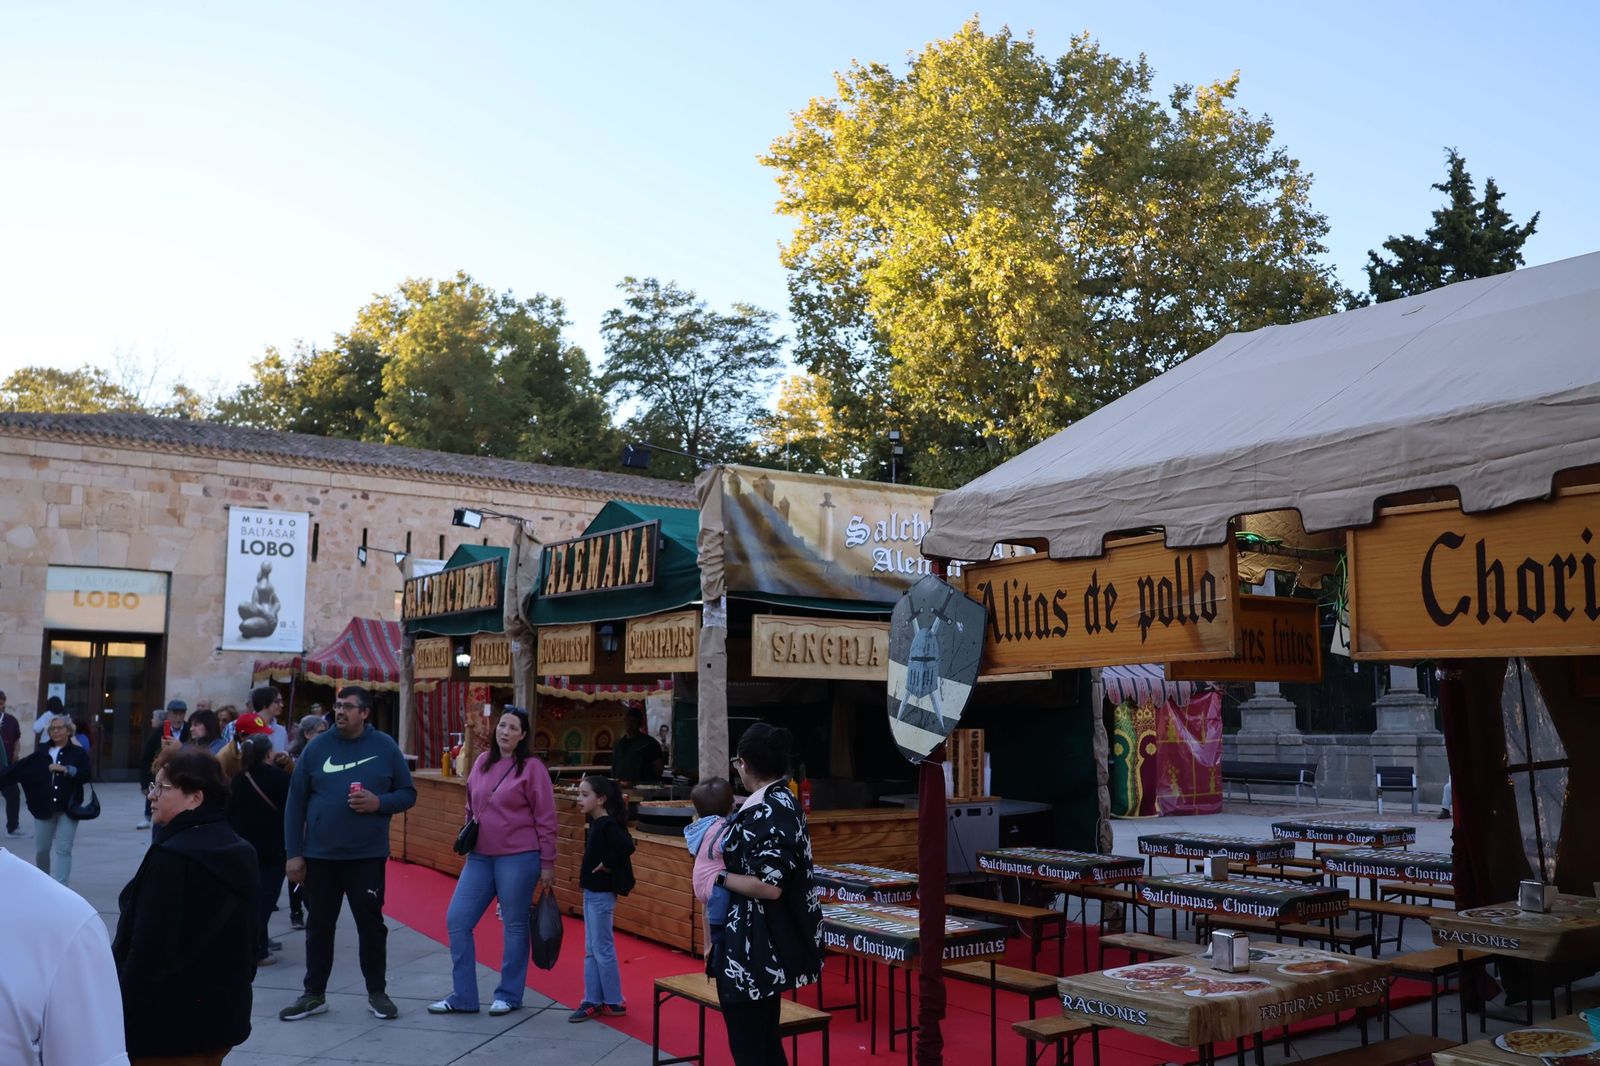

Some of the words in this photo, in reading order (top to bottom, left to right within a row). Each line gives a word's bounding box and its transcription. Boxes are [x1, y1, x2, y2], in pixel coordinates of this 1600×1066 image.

[242, 515, 297, 527] MUSEO
[240, 526, 296, 541] BALTASAR
[240, 540, 295, 558] LOBO
[545, 526, 650, 595] ALEMANA
[1421, 528, 1600, 627] Chori
[73, 589, 141, 610] LOBO
[977, 578, 1069, 644] Alitas
[1084, 569, 1118, 636] de
[1137, 553, 1218, 645] pollo
[630, 626, 694, 660] CHORIPAPAS
[771, 631, 881, 667] SANGRIA
[1272, 616, 1314, 665] fritos
[1306, 829, 1334, 841] Bacon
[1346, 831, 1376, 844] Queso
[1175, 843, 1204, 857] Bacon
[1216, 848, 1250, 861] Queso
[1038, 864, 1082, 881] Choripan
[1092, 866, 1143, 881] Alemanas
[1404, 866, 1453, 882] Choripa
[1141, 887, 1218, 911] Salchipapas,
[1222, 897, 1280, 919] Choripan
[853, 934, 907, 962] Choripan
[942, 936, 1007, 960] emanas
[1438, 928, 1521, 950] RACIONES
[1061, 993, 1149, 1026] RACIONES
[1260, 993, 1325, 1020] FRITURAS
[1326, 988, 1342, 1004] DE
